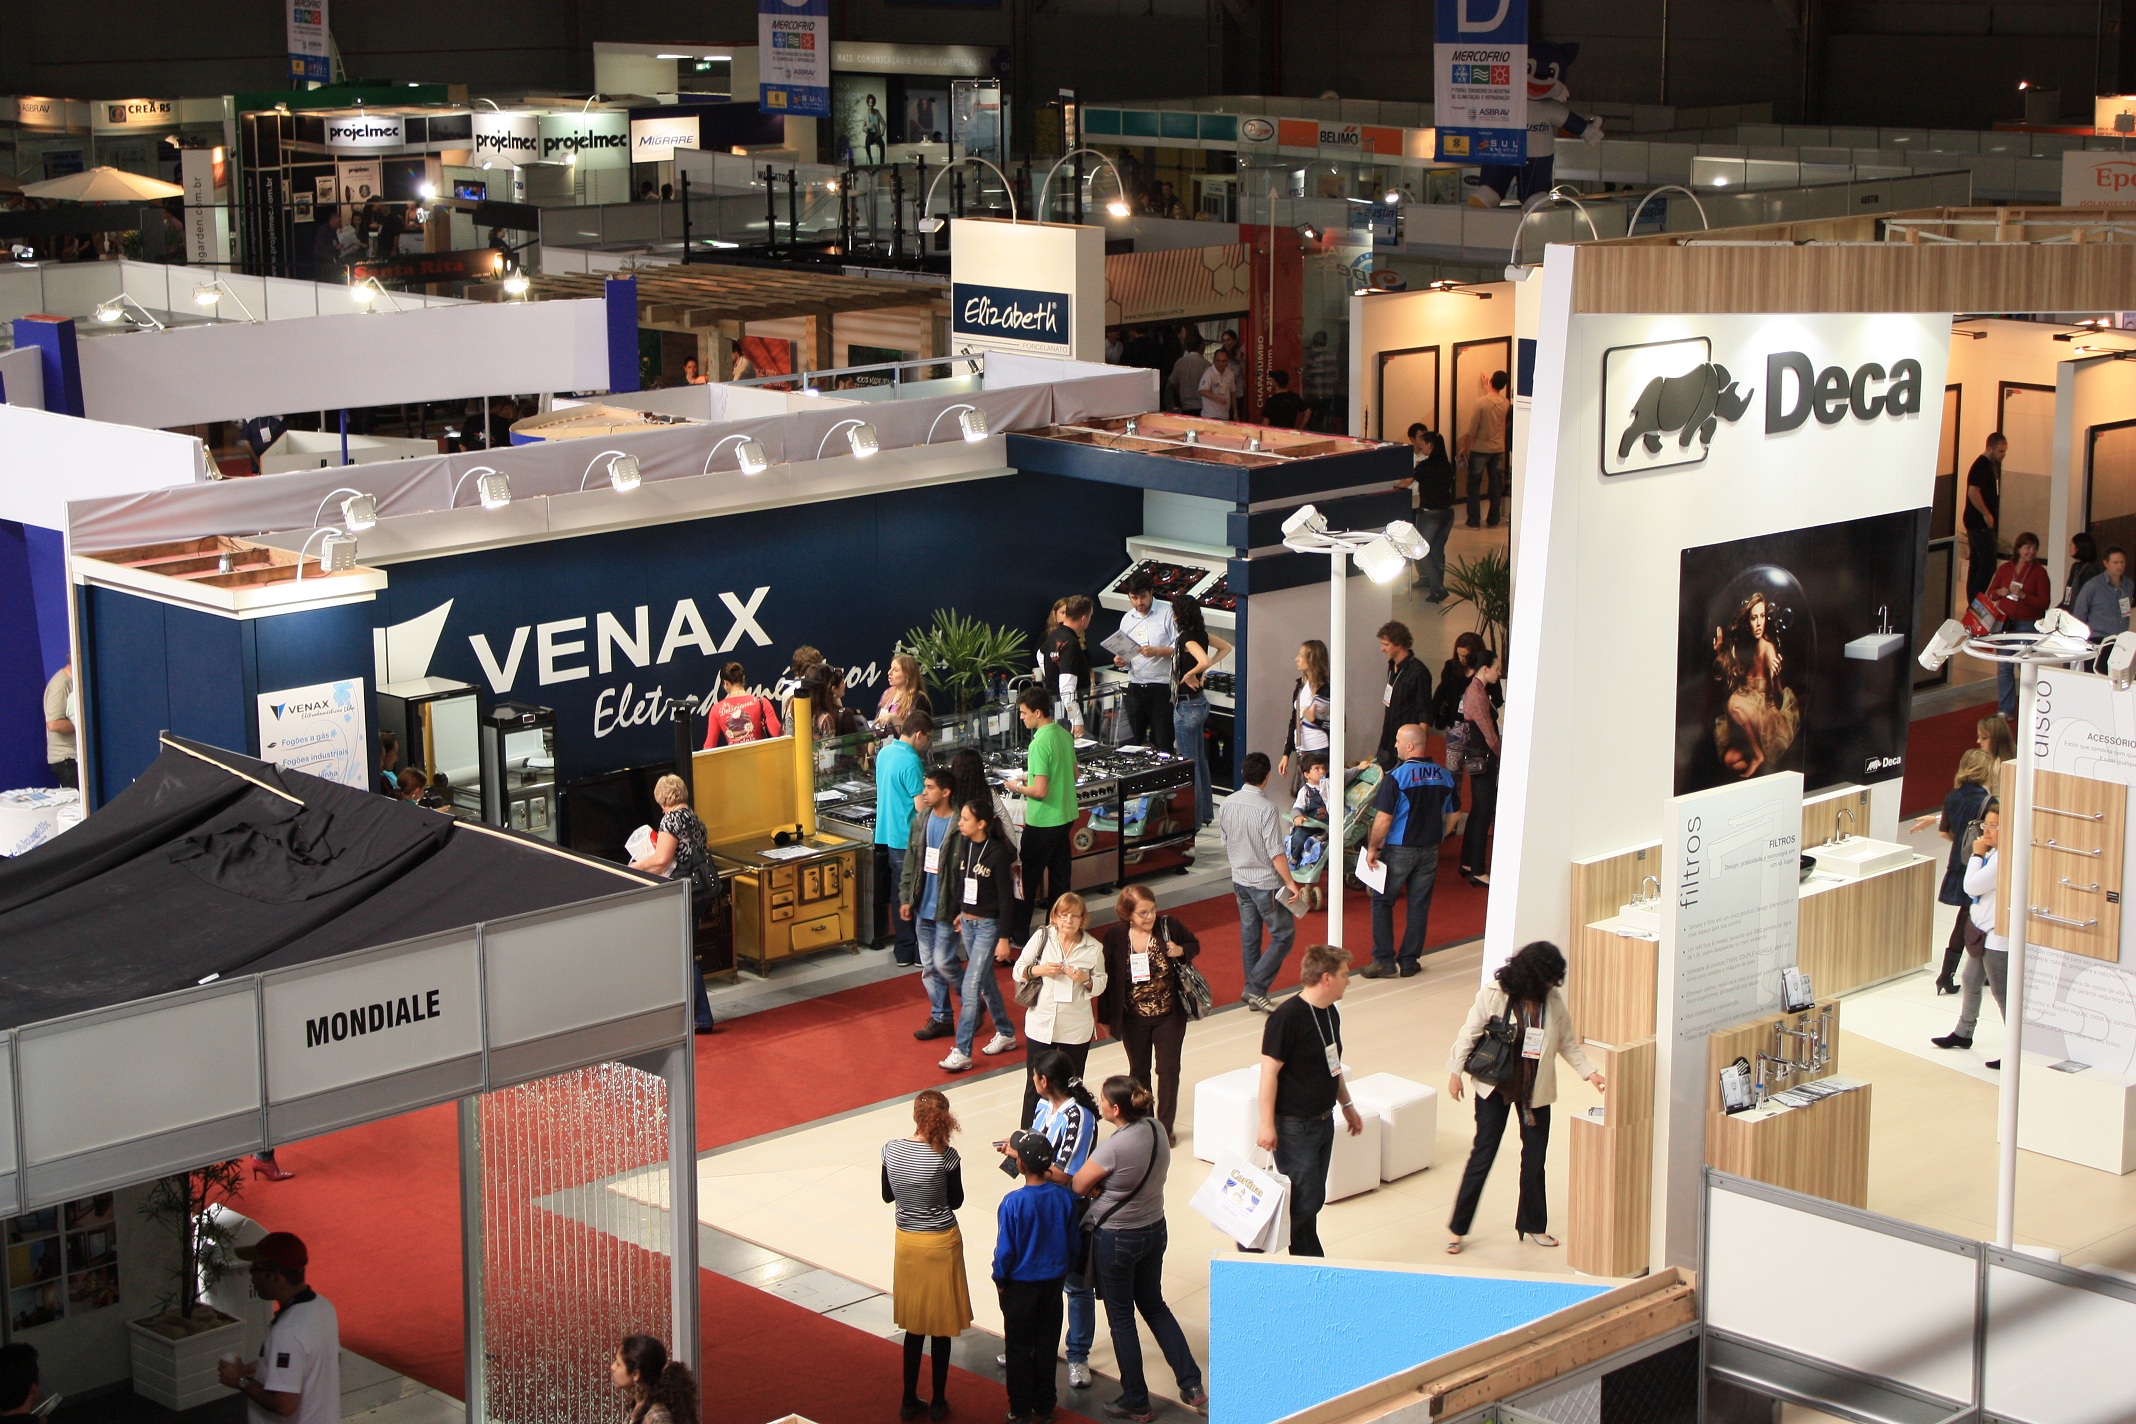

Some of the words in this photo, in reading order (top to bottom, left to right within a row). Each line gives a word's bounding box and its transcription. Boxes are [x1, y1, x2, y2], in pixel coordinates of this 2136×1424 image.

[772, 21, 815, 30] MERCOFRIO
[1452, 51, 1510, 62] MERCOFRIO
[22, 104, 50, 113] ASBRAV
[1479, 108, 1510, 116] ASBRAV
[330, 124, 399, 141] projelmec
[1526, 122, 1550, 133] ustin
[476, 129, 537, 153] projelmec
[544, 130, 628, 156] projelmec
[1320, 131, 1358, 146] BELIMO
[1364, 206, 1395, 218] austin
[354, 264, 414, 279] Santa
[420, 261, 465, 273] Rita
[964, 296, 1057, 333] Elizabeth
[1022, 343, 1068, 354] PORCELANATO
[1765, 350, 1922, 435] Deca
[468, 586, 774, 694] VENAX
[288, 700, 330, 714] VENAX
[282, 736, 308, 747] Fogões
[317, 732, 330, 742] gás
[283, 756, 309, 767] Fogões
[311, 749, 349, 760] industriais
[2091, 746, 2113, 755] combina
[1882, 757, 1901, 768] Deca
[1412, 766, 1442, 782] LINK
[1769, 835, 1796, 849] FILTROS
[1680, 815, 1702, 910] filtros
[306, 989, 440, 1049] MONDIALE
[1231, 1169, 1264, 1198] Cortinas
